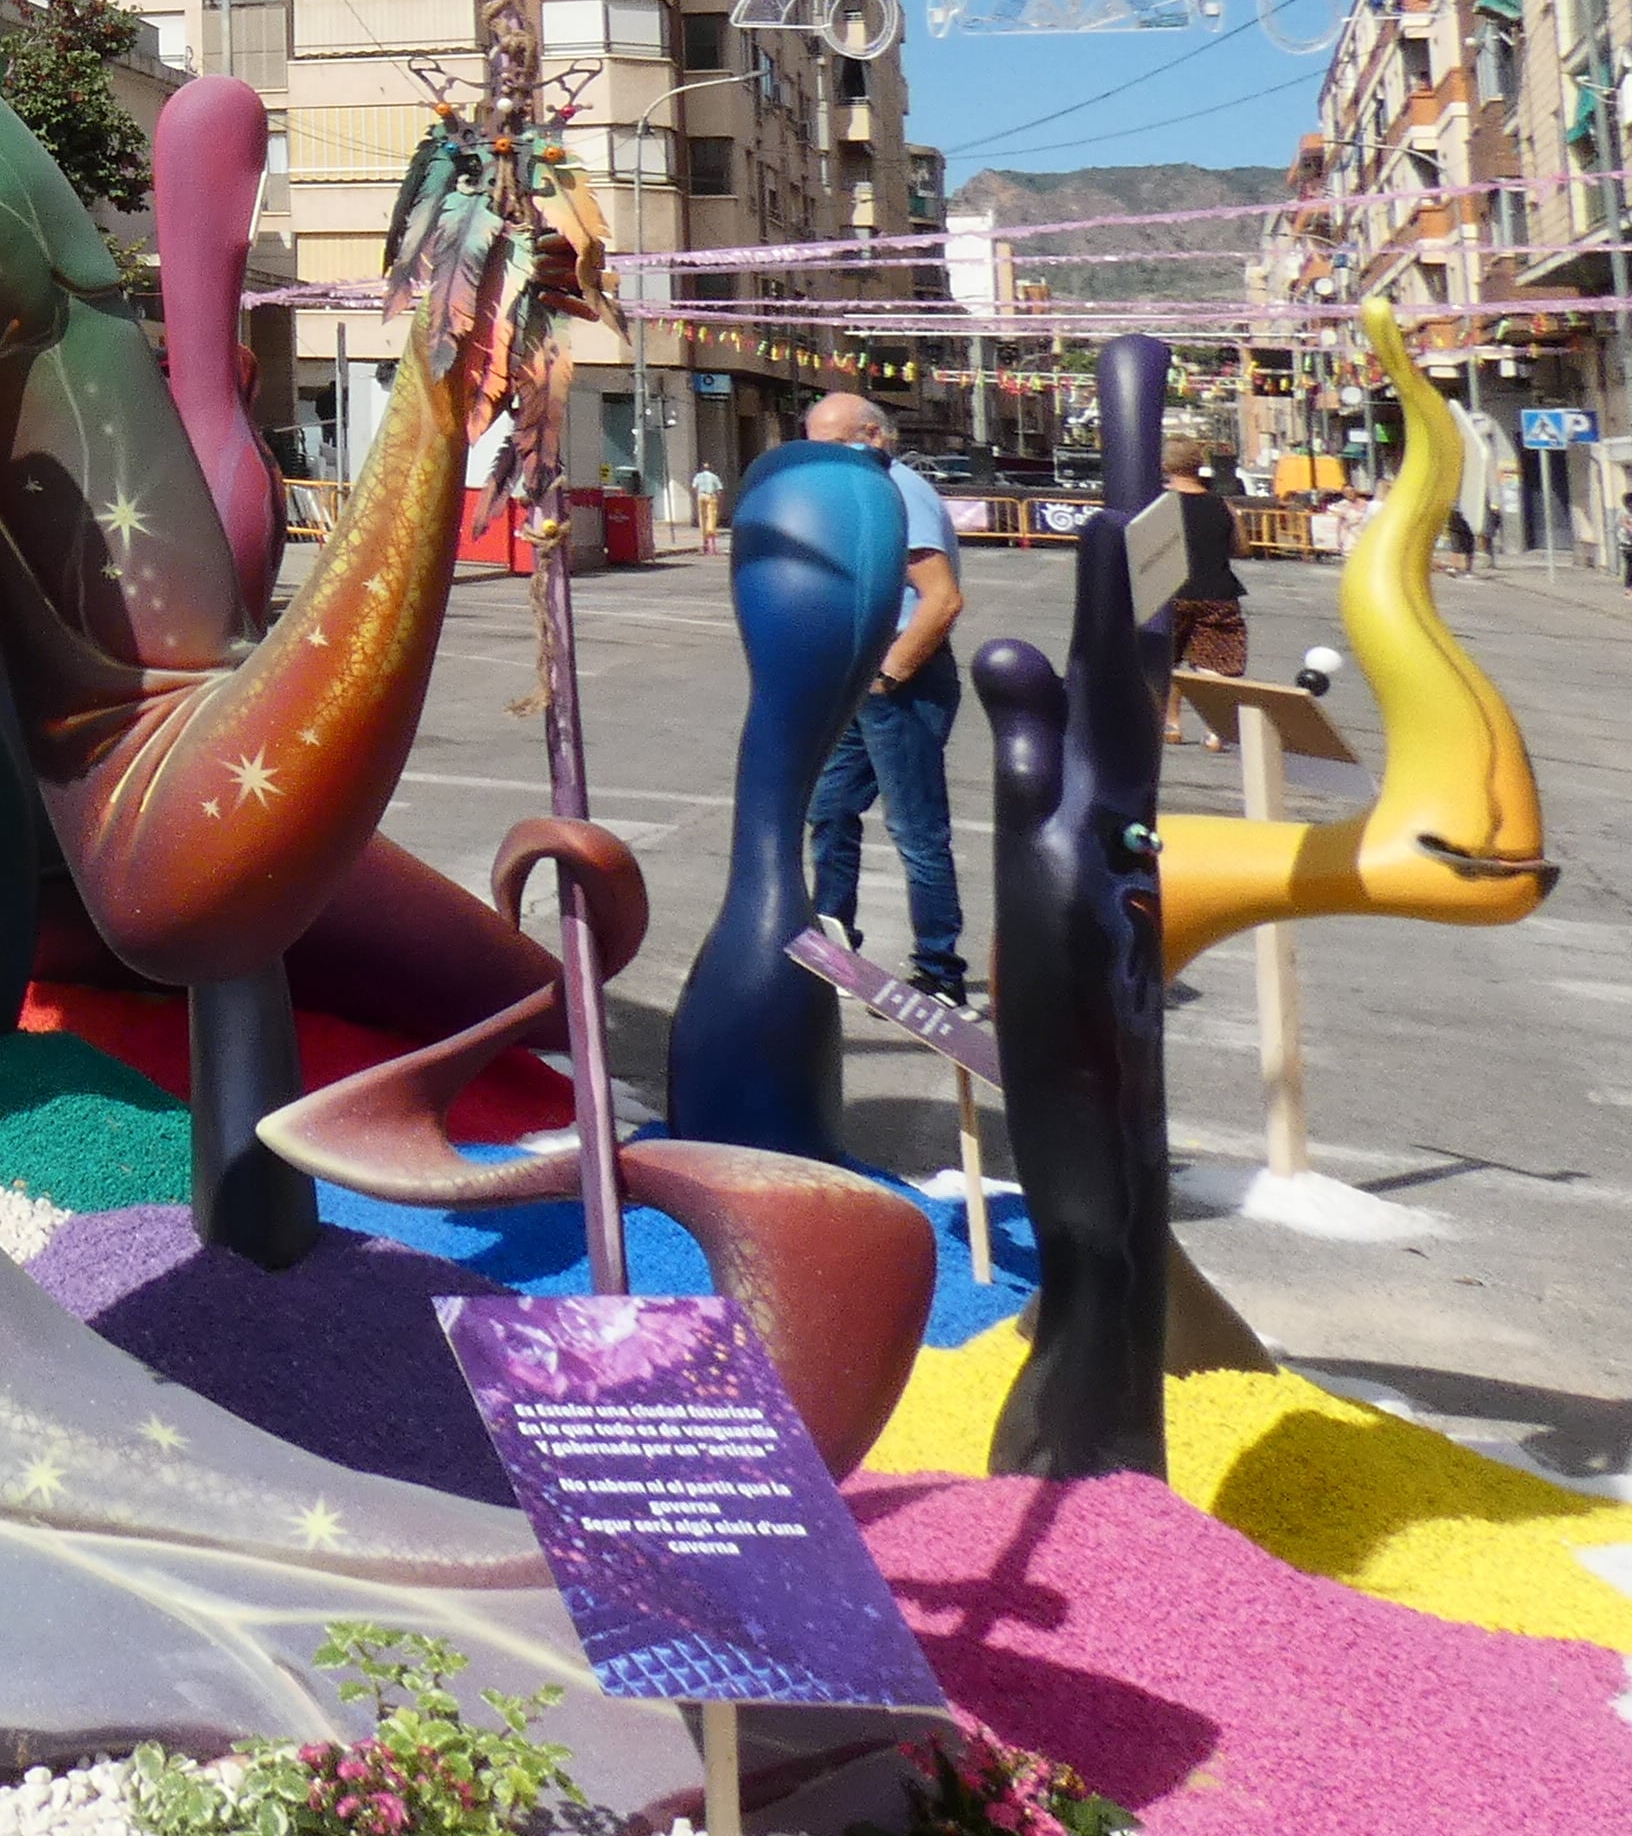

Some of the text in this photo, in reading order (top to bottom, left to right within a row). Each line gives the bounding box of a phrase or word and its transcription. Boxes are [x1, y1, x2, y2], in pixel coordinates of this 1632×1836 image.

[1567, 414, 1589, 440] P
[514, 1404, 535, 1416] Es
[595, 1405, 629, 1417] una
[630, 1404, 687, 1418] ciudad
[518, 1422, 778, 1440] En la que todo es de vanguardia
[534, 1440, 548, 1454] Y
[551, 1440, 642, 1457] gobernada
[641, 1443, 672, 1459] por
[674, 1444, 700, 1456] un
[559, 1478, 587, 1492] No
[646, 1479, 667, 1493] ni
[667, 1479, 685, 1494] el
[737, 1483, 772, 1499] que
[770, 1480, 793, 1496] la
[649, 1501, 721, 1516] governa
[668, 1540, 740, 1555] caverna
